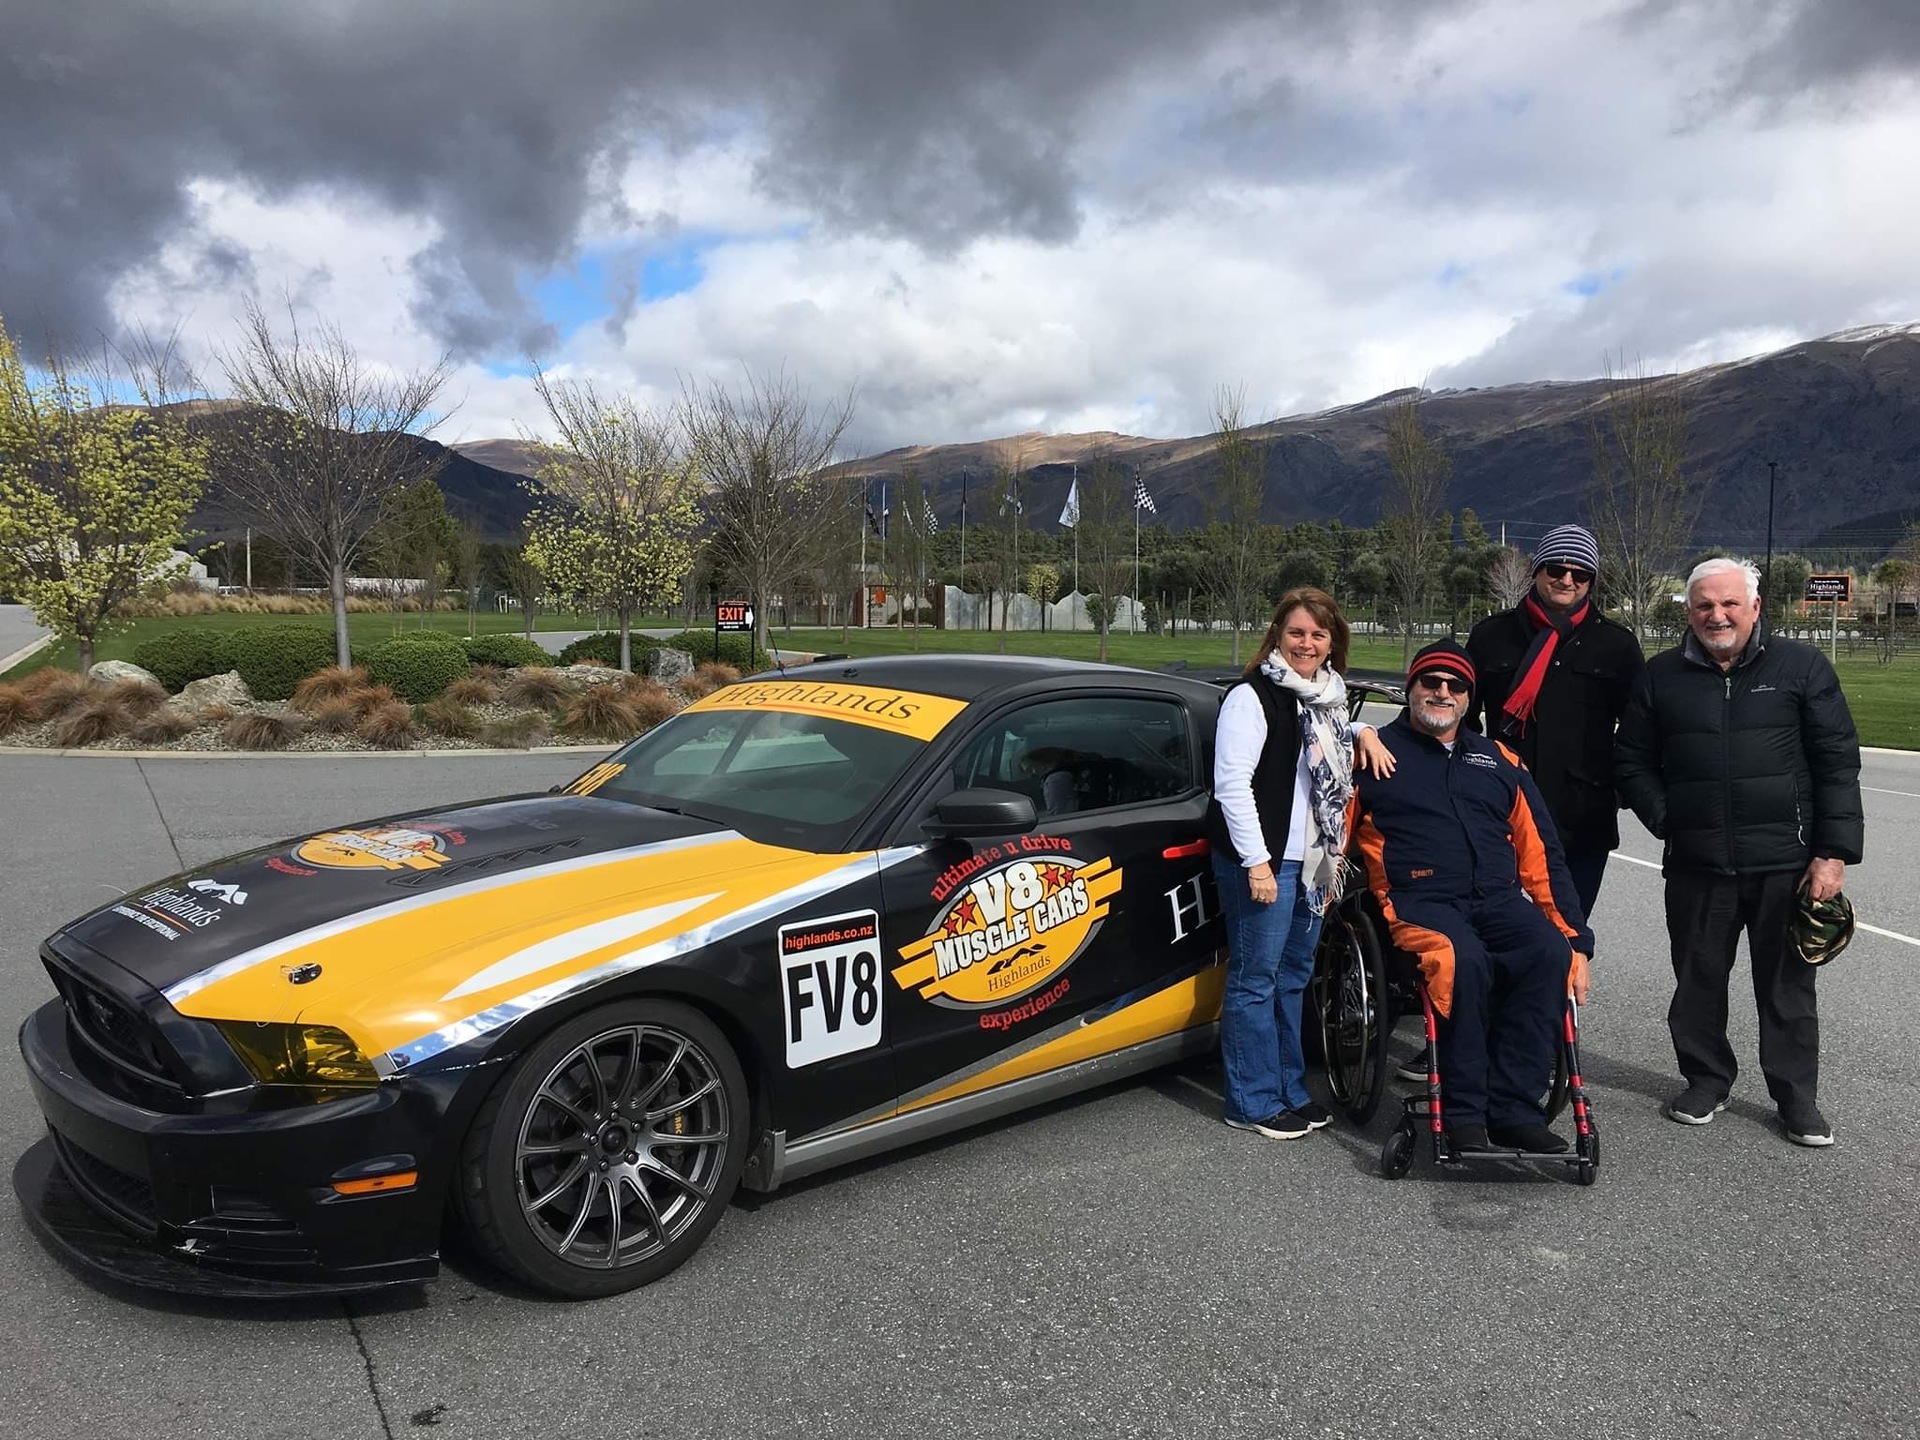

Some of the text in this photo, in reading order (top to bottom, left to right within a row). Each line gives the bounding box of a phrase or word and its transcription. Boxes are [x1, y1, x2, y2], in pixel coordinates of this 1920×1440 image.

[718, 607, 744, 620] EXIT
[714, 683, 920, 720] Highlands
[930, 834, 1072, 901] ultimate u drive
[140, 887, 222, 927] Highlands
[969, 862, 1044, 926] V8
[784, 925, 874, 950] highlands.co.nz
[932, 878, 1089, 979] MUSCLE CARS
[786, 951, 878, 1044] FV8
[987, 955, 1052, 993] Highlands
[979, 977, 1071, 1031] experience
